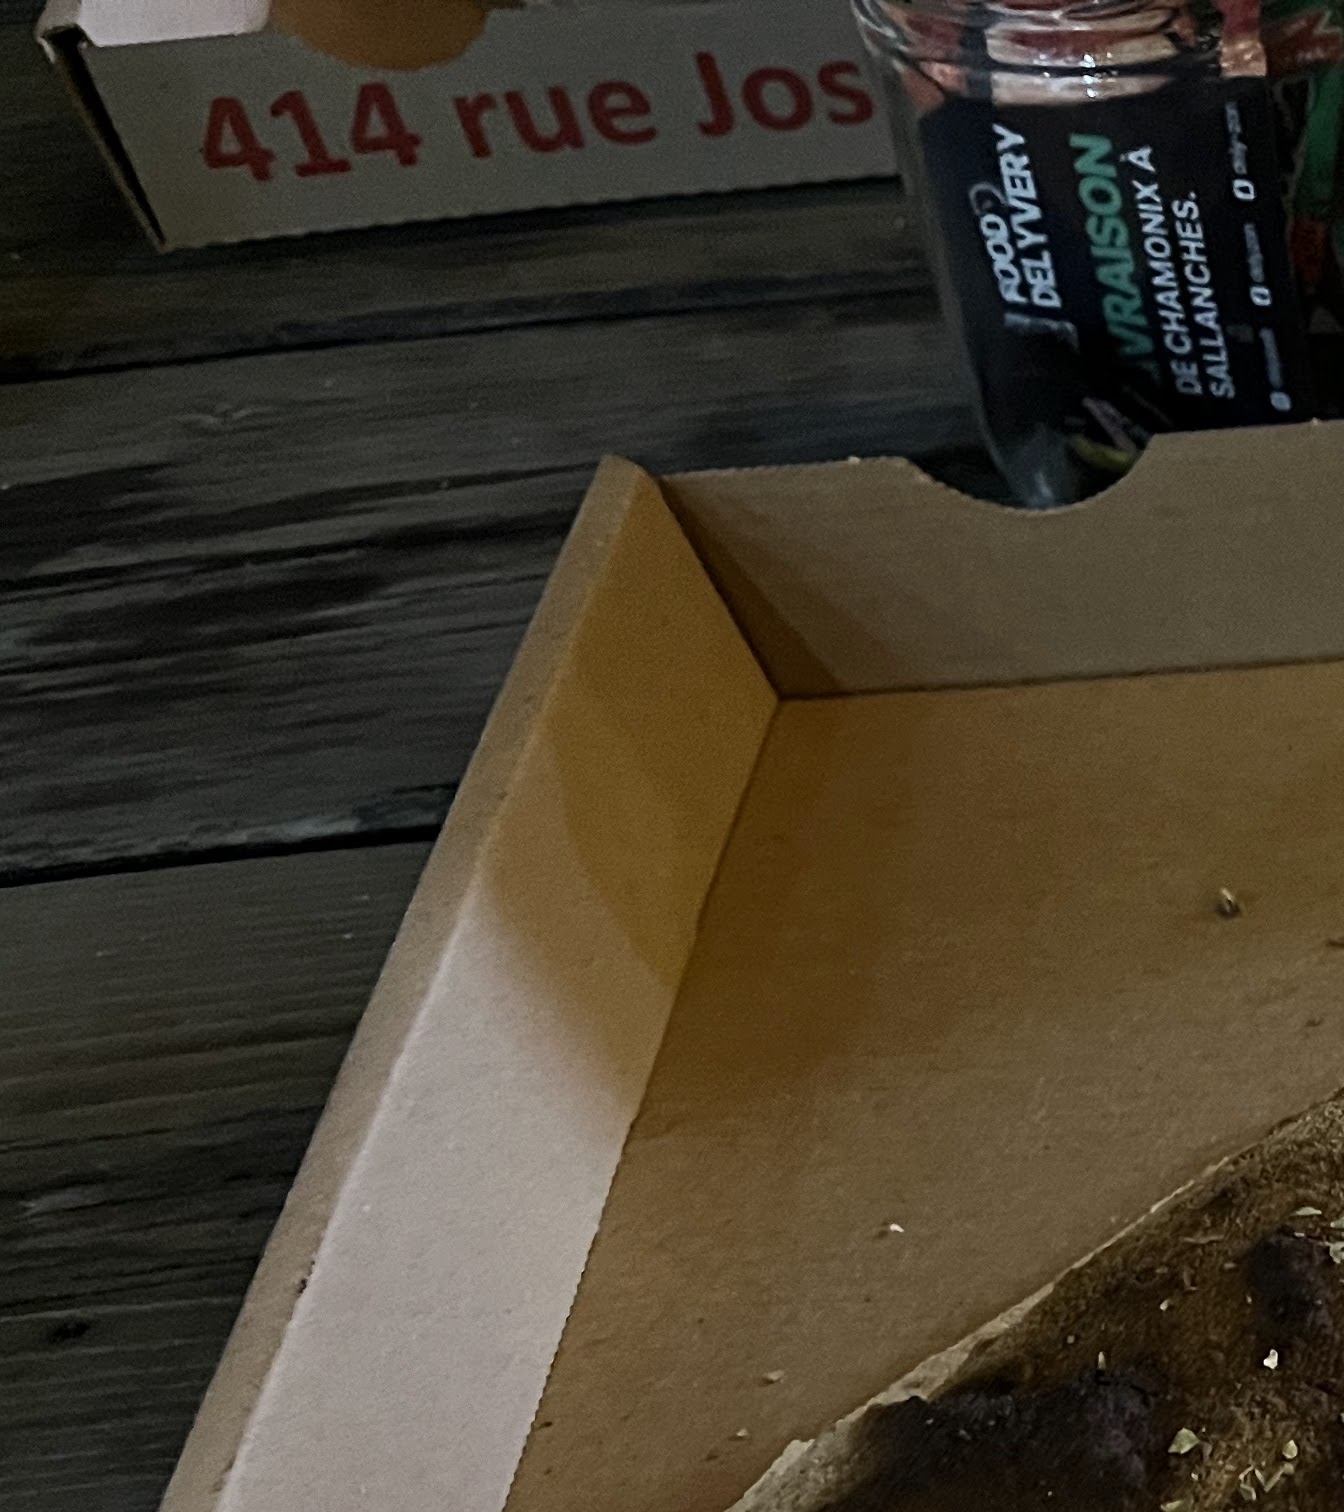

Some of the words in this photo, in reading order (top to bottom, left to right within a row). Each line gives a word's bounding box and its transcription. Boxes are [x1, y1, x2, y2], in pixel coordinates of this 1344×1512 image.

[202, 81, 422, 181] 414
[452, 80, 656, 158] rue
[695, 52, 875, 138] Jos
[1119, 144, 1156, 174] À
[992, 122, 1062, 308] DELYVERY
[1068, 132, 1164, 385] VRAISON
[1130, 178, 1194, 356] CHAMONIX
[1171, 190, 1236, 400] SALLANCHES.
[1168, 357, 1203, 397] DE
